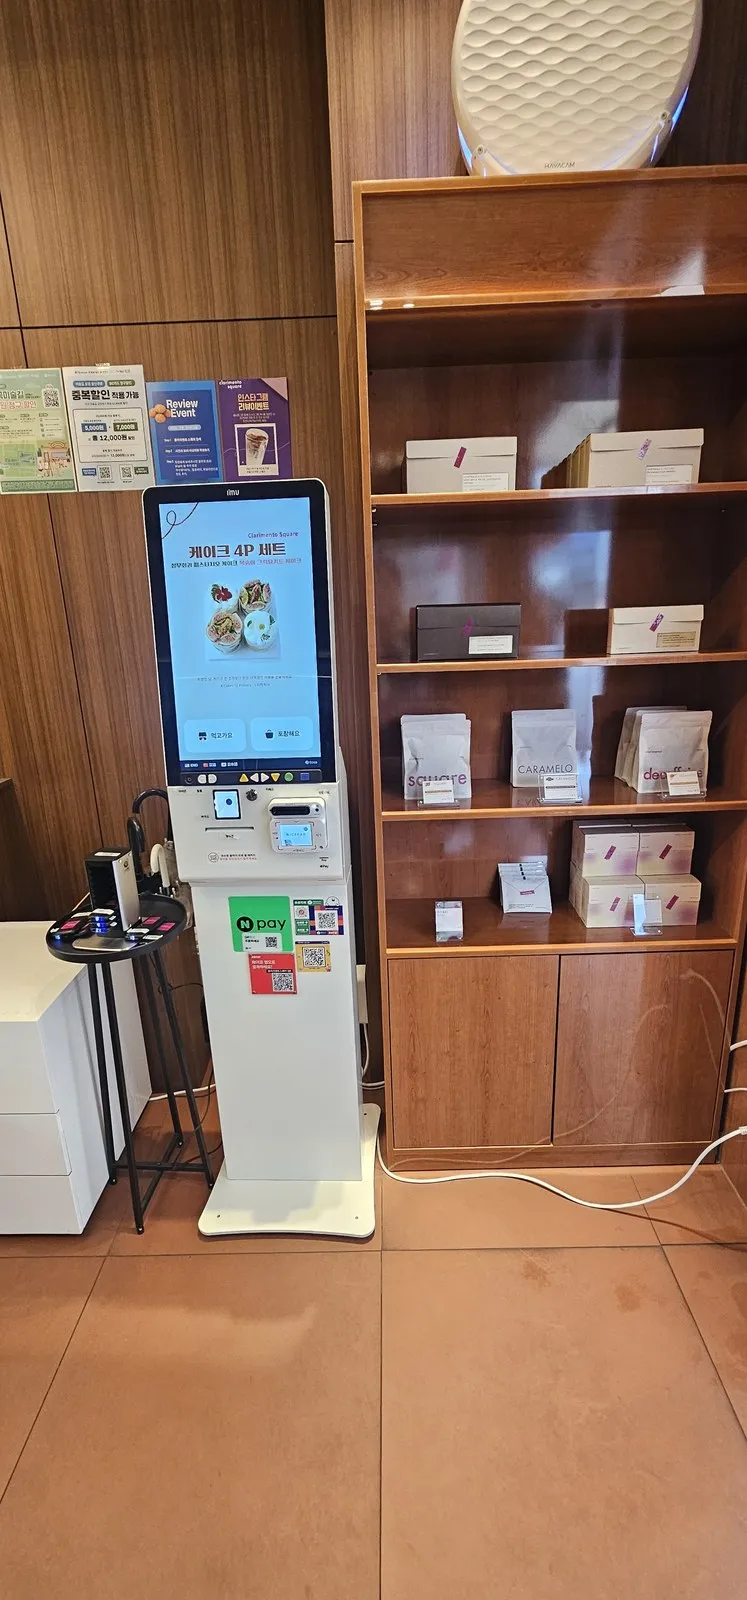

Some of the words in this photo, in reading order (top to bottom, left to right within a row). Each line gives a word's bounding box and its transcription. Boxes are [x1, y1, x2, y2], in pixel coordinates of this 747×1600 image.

[72, 389, 110, 401] 중복할인
[166, 399, 198, 409] Review
[170, 408, 196, 418] Event
[279, 531, 299, 539] Square
[188, 545, 231, 559] 케이크
[233, 544, 255, 557] 4P
[258, 542, 286, 556] 세트
[517, 764, 574, 775] CARAMELO
[257, 919, 287, 930] pay
